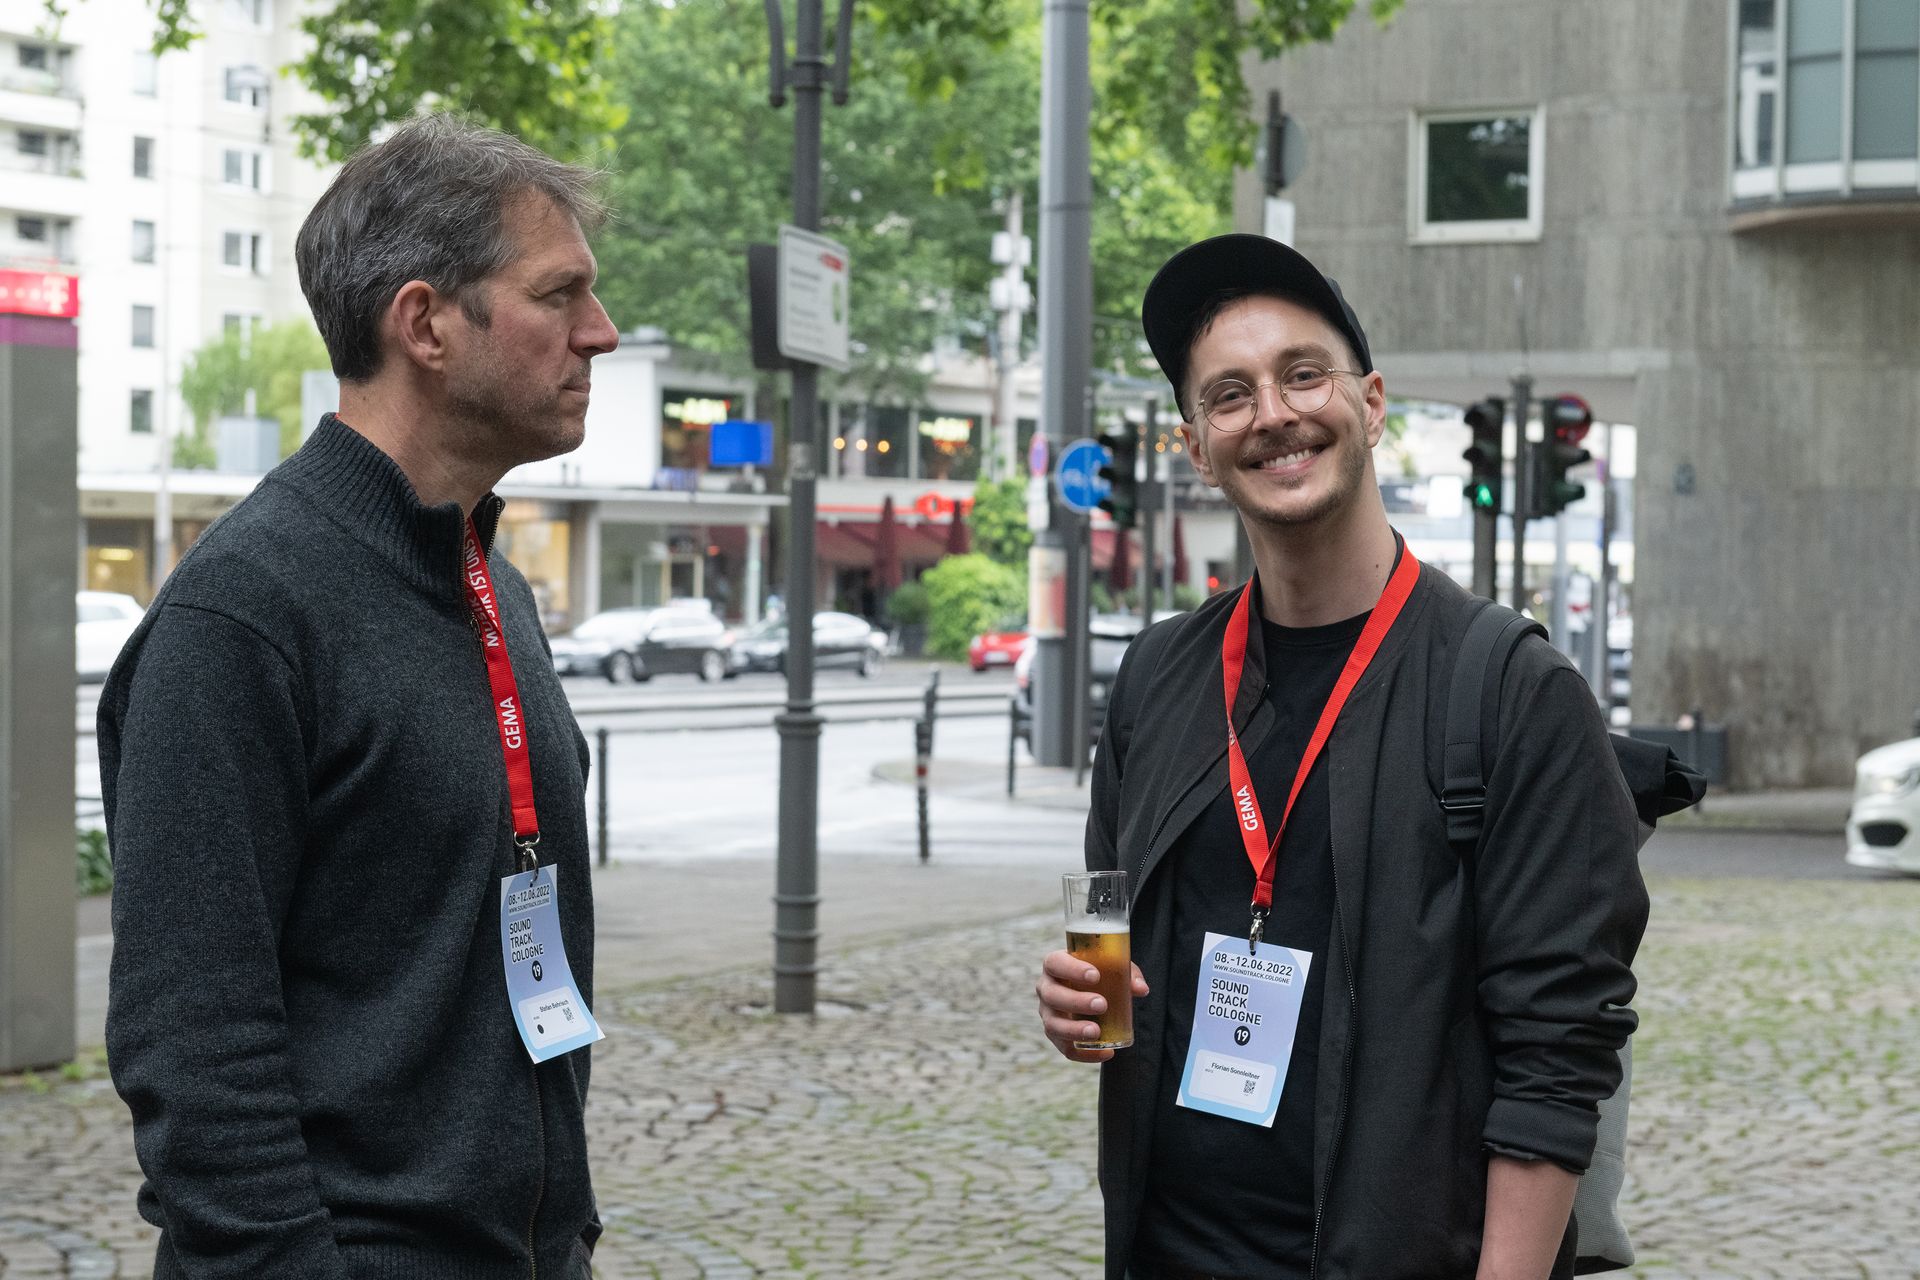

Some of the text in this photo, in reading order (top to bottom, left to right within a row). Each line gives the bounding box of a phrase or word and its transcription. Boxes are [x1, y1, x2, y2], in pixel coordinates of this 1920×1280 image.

[465, 538, 480, 569] UNS
[468, 570, 488, 590] IST
[500, 696, 522, 749] GEMA
[1236, 785, 1259, 831] GEMA
[509, 918, 532, 935] SOUND
[510, 933, 533, 949] TRACK
[511, 943, 544, 963] COLOGNE
[532, 964, 541, 977] 19
[1213, 964, 1290, 984] WWW.SOUNDTRACK.COLOGNE
[1214, 952, 1293, 977] 08.-12.06.2022
[1211, 978, 1249, 995] SOUND
[1210, 991, 1248, 1009] TRACK
[1208, 1004, 1262, 1026] COLOGNE
[1236, 1029, 1249, 1042] 19
[1211, 1062, 1230, 1073] Florian
